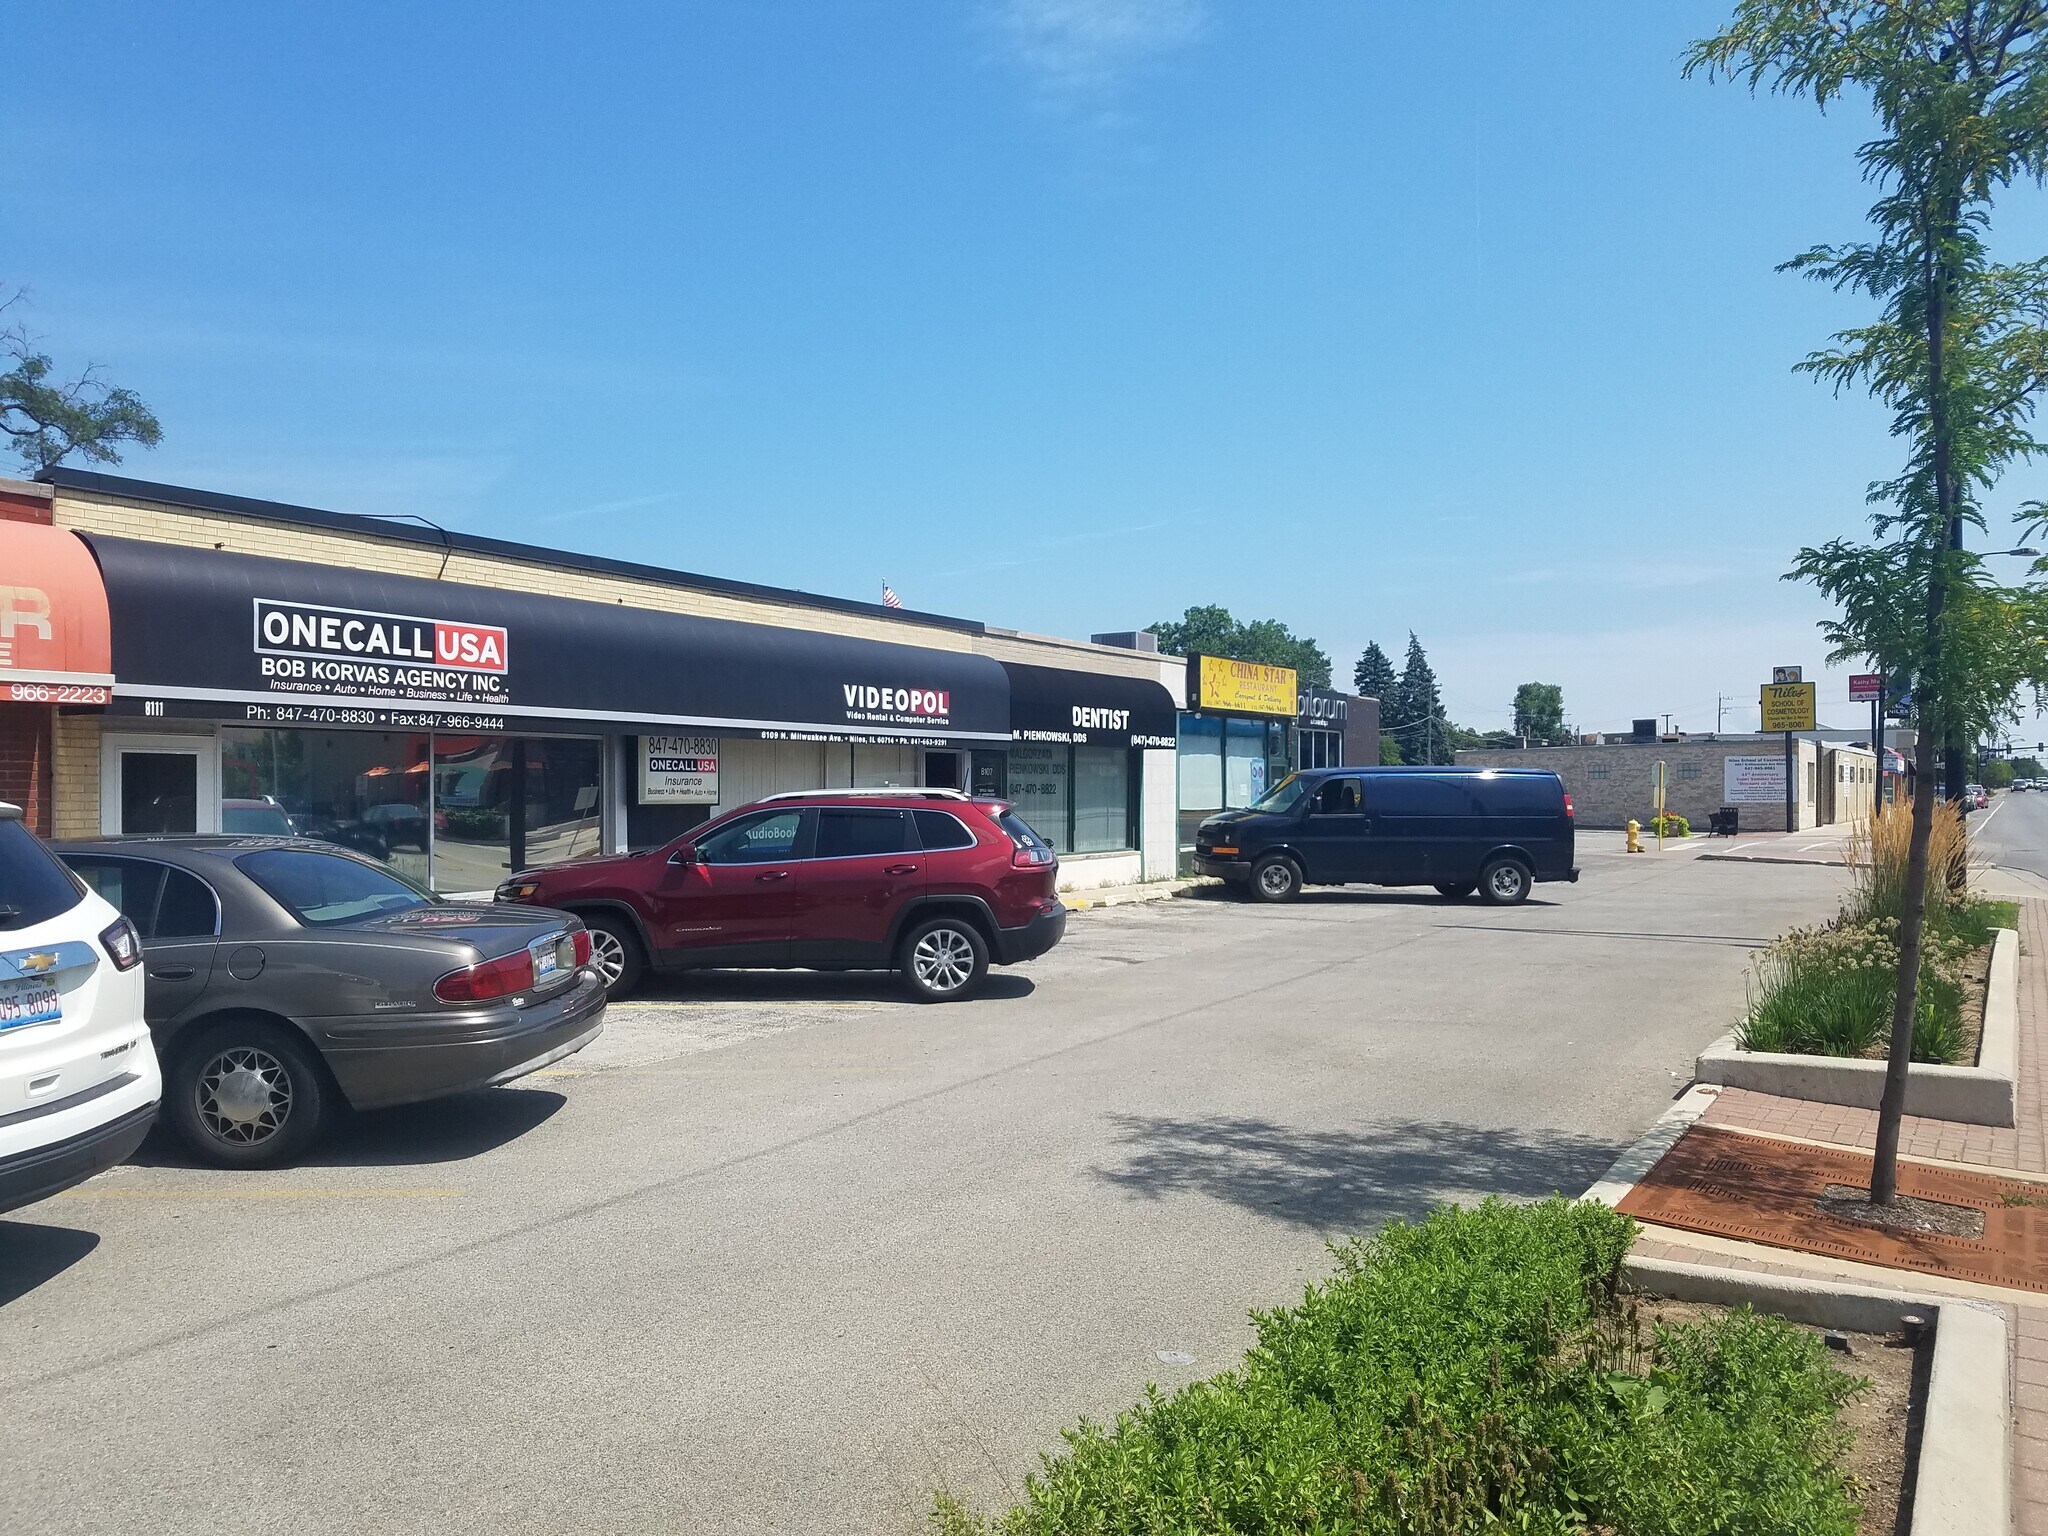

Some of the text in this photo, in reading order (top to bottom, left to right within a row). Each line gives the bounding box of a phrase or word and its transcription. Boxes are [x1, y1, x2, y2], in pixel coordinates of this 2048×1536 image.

[263, 611, 502, 665] ONECALL USA
[261, 658, 306, 678] BOB
[312, 662, 390, 684] KORVAS
[394, 669, 468, 690] AGENCY
[1230, 662, 1287, 685] CHINA STAR
[11, 683, 106, 703] 966-2223
[270, 679, 509, 704] Insurance Auto Home Business Life Health
[1240, 681, 1278, 693] RESTAURANT
[1769, 686, 1807, 698] Niles
[843, 684, 948, 714] VIDEOPOL
[145, 700, 164, 717] 8111
[247, 705, 271, 720] Ph:
[276, 707, 375, 724] 847-470-8830
[1767, 707, 1809, 715] COSMETOLOGY
[846, 711, 866, 720] Video
[867, 712, 888, 721] Rental
[895, 715, 926, 725] Computer
[926, 717, 950, 725] Service
[1072, 705, 1130, 730] DENTIST
[761, 731, 779, 740] 8109
[780, 732, 789, 740] N.
[829, 734, 844, 743] Ave.
[849, 735, 868, 745] Niles,
[869, 736, 876, 744] IL
[900, 737, 910, 745] Ph.
[1012, 729, 1088, 744] M. PIENKOWSKI, DDS
[648, 736, 717, 755] 847-470-8830
[697, 760, 716, 771] USA
[980, 767, 994, 776] 8107
[664, 775, 702, 786] Insurance
[647, 787, 665, 795] Business
[26, 988, 58, 1016] 8099
